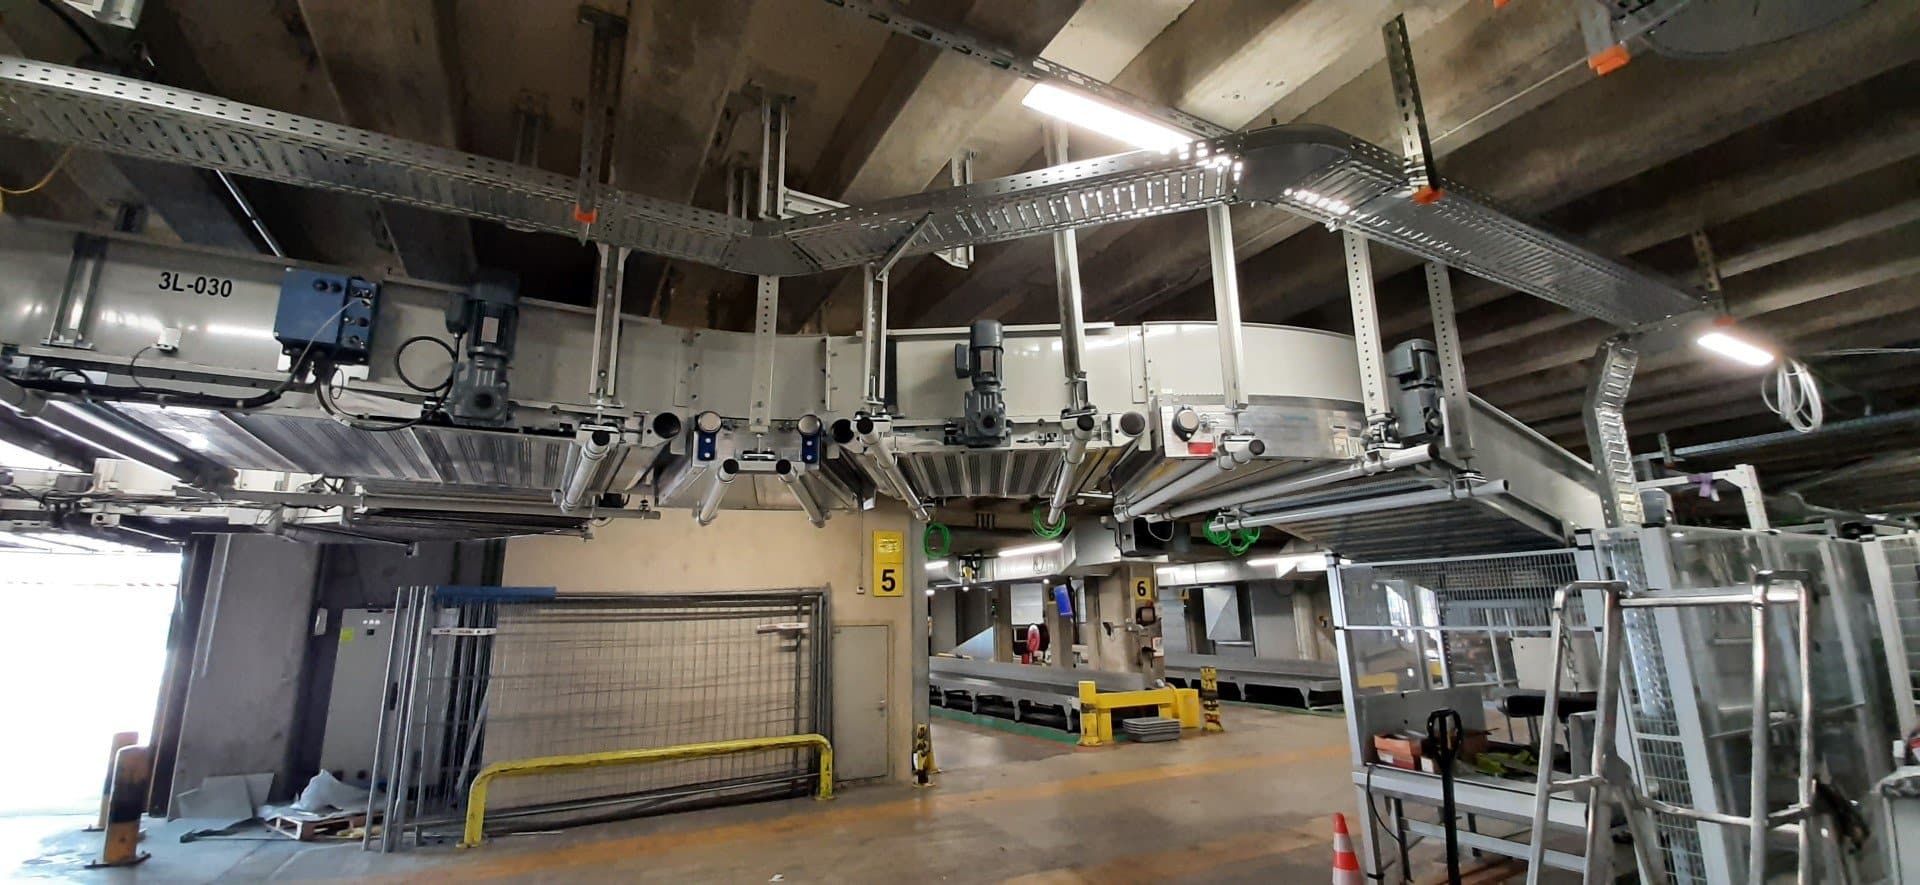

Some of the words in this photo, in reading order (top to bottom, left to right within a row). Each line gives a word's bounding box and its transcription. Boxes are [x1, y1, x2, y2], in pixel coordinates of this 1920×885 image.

[158, 271, 233, 298] 3L-030
[881, 568, 896, 593] 5
[1136, 580, 1147, 597] 6
